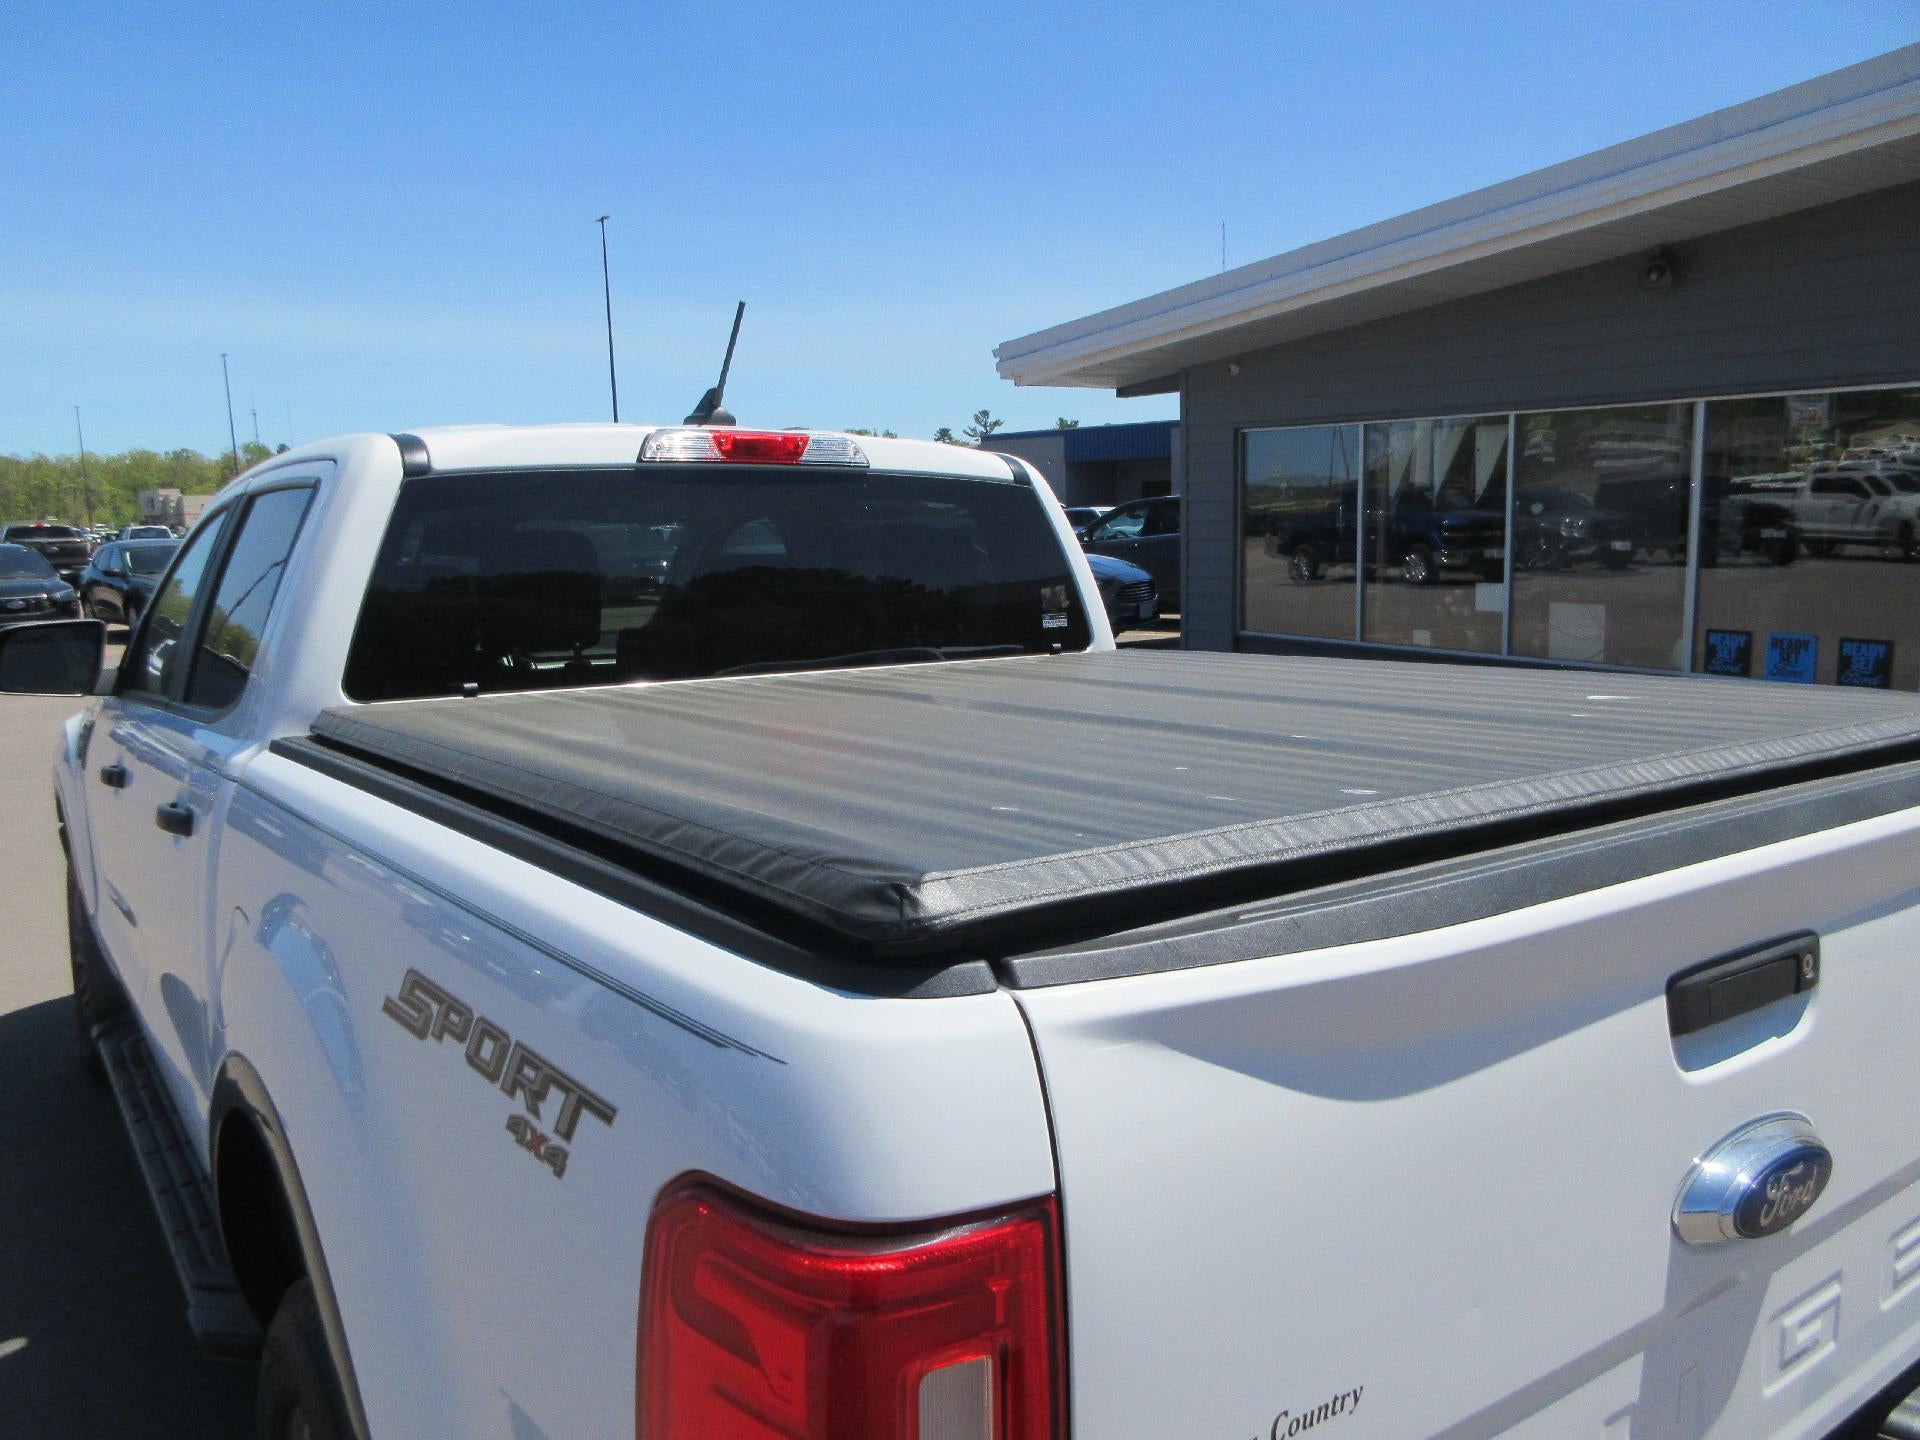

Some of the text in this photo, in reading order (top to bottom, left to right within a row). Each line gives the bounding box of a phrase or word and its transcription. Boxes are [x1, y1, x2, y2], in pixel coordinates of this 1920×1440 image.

[1709, 633, 1745, 647] READY
[1771, 637, 1810, 651] READY
[1716, 647, 1736, 660] SET
[1842, 641, 1886, 657] READY
[1779, 650, 1799, 664] SET
[1707, 659, 1743, 673] Ford
[1769, 663, 1810, 678] Ford
[1852, 657, 1874, 672] SET
[1841, 671, 1882, 685] Ford
[382, 967, 618, 1144] SPORT
[1759, 1160, 1817, 1227] Ford
[1271, 1385, 1364, 1440] Country
